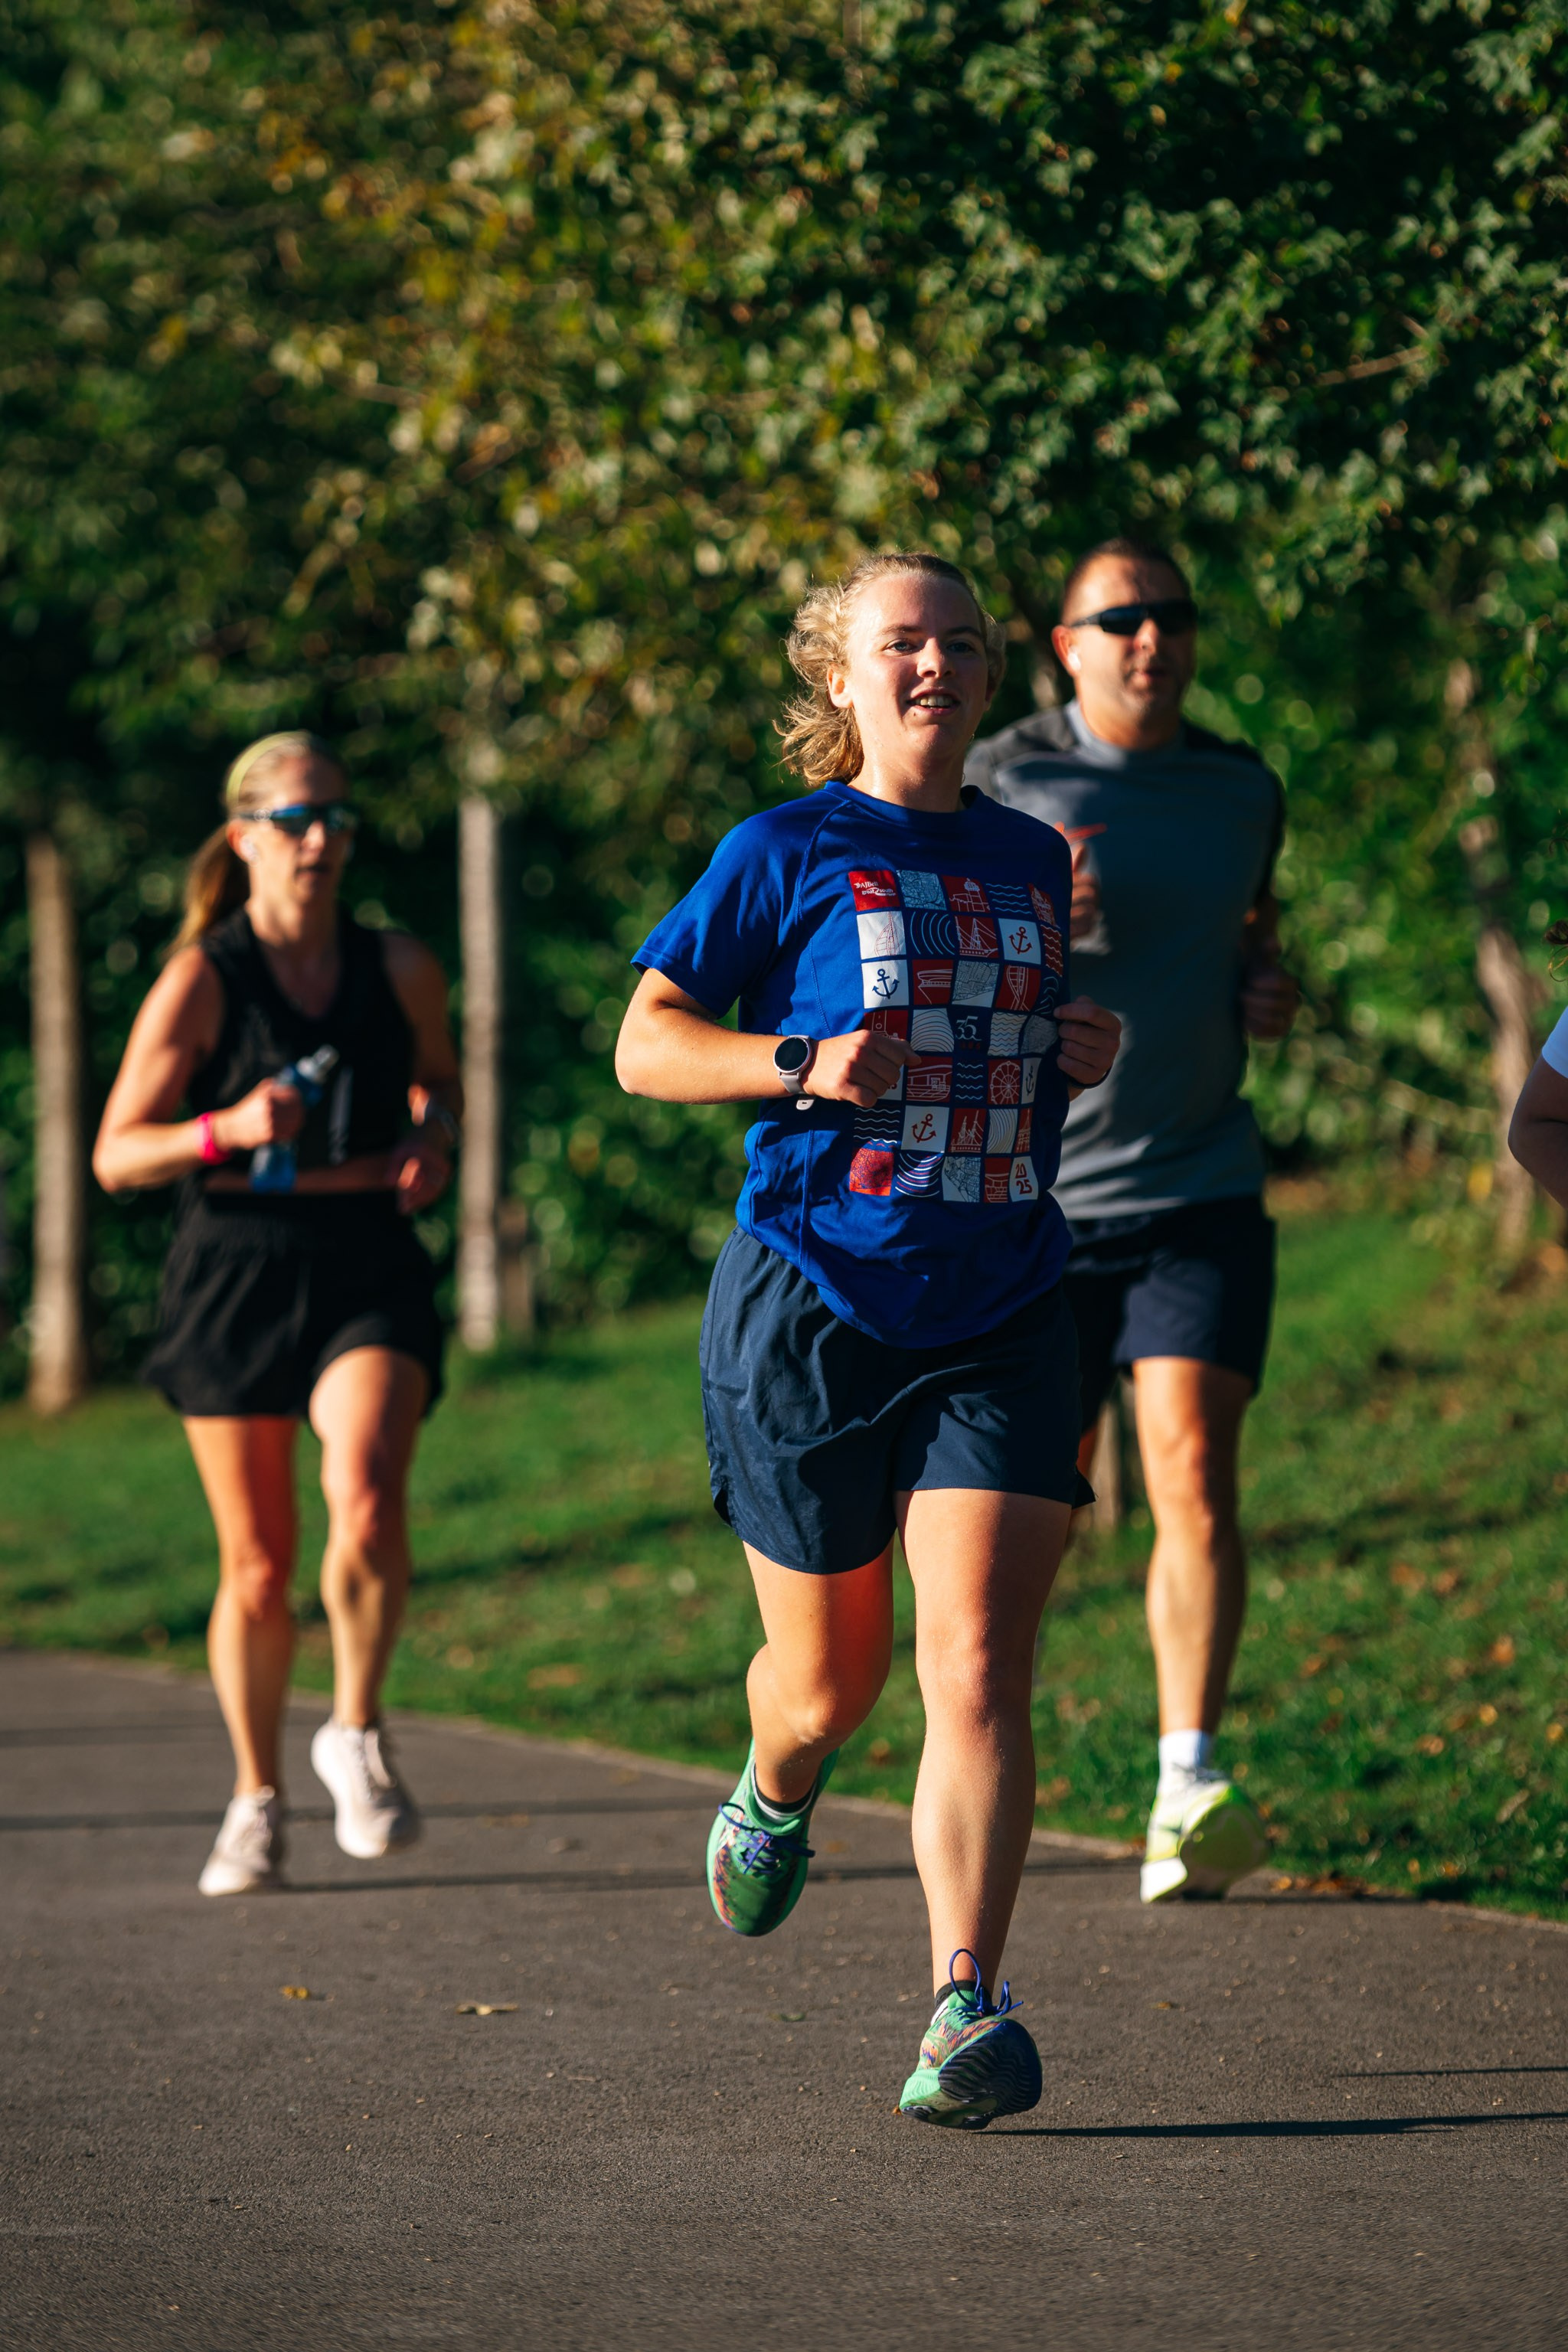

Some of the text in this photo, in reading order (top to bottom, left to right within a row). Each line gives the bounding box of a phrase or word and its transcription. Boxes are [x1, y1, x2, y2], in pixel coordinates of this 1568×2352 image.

[956, 1015, 979, 1040] 35
[1015, 1163, 1027, 1178] 20
[1016, 1179, 1033, 1194] 25
